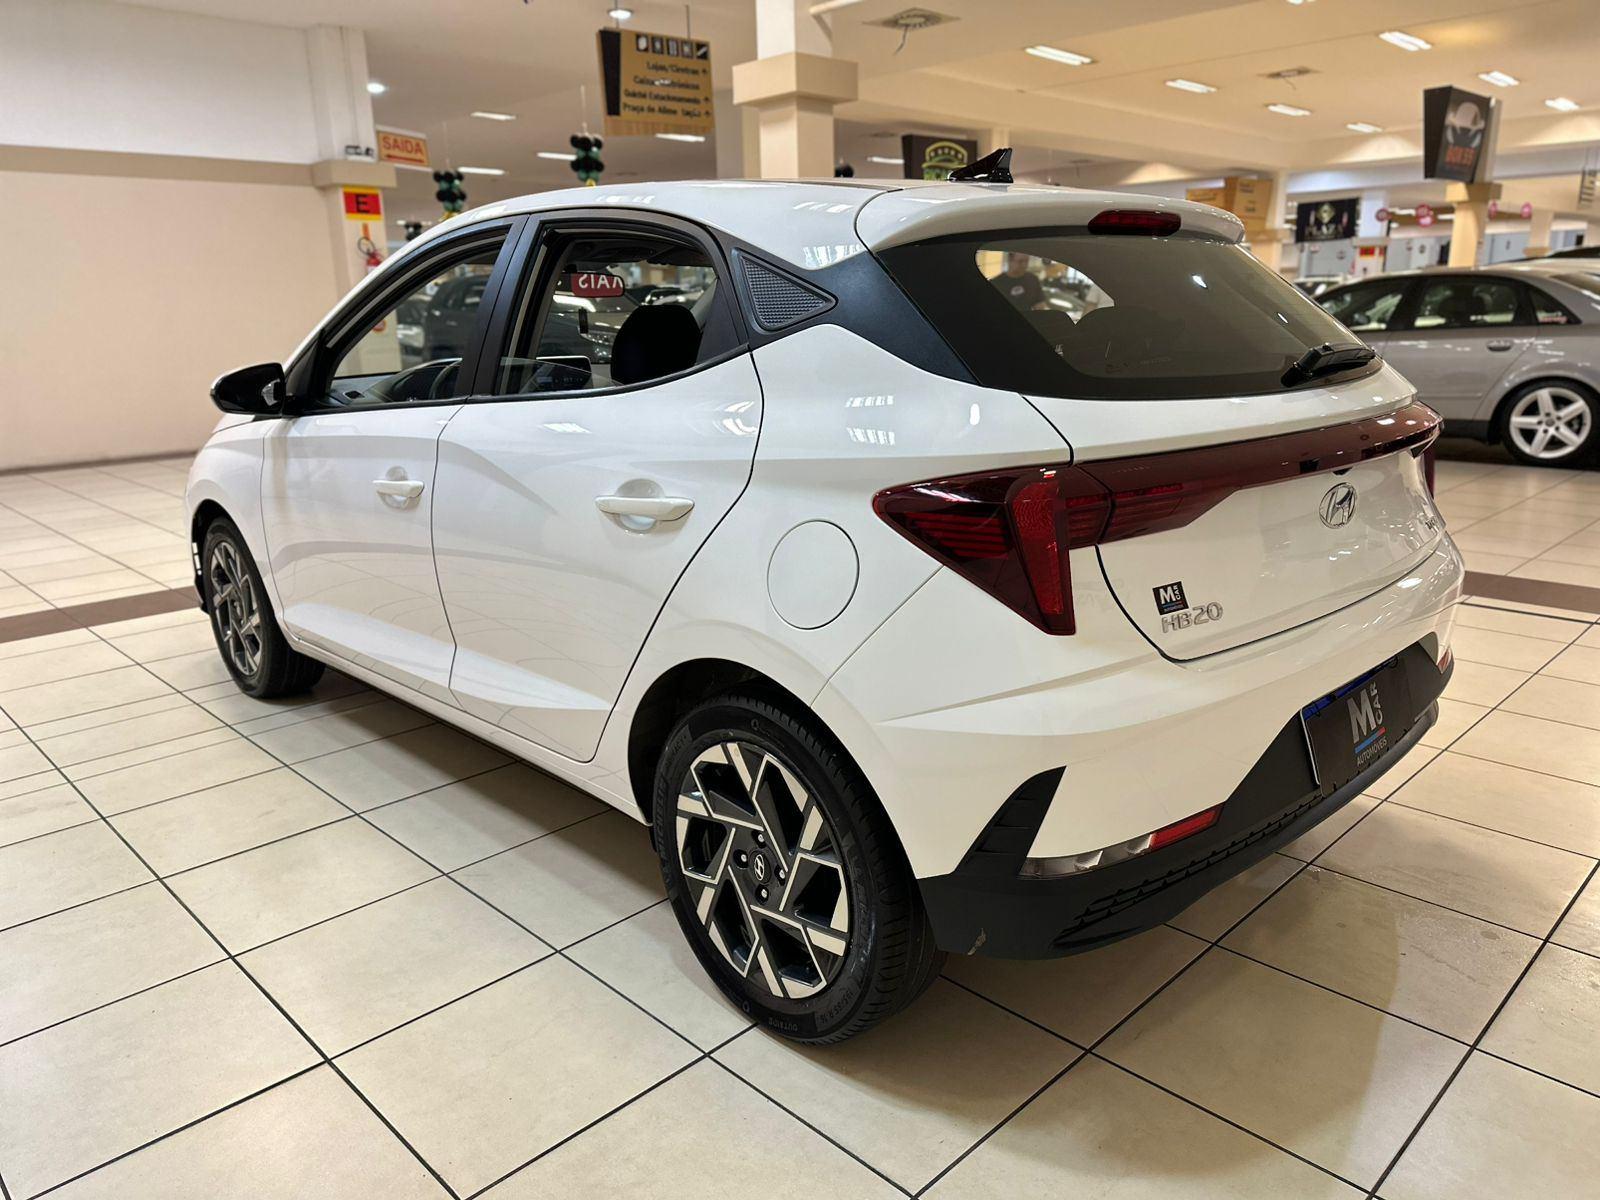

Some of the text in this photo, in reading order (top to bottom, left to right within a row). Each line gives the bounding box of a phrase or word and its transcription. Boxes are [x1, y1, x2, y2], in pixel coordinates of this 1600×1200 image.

[355, 193, 370, 213] E
[1159, 586, 1177, 604] M
[1161, 602, 1223, 633] HB20
[1347, 688, 1377, 744] M
